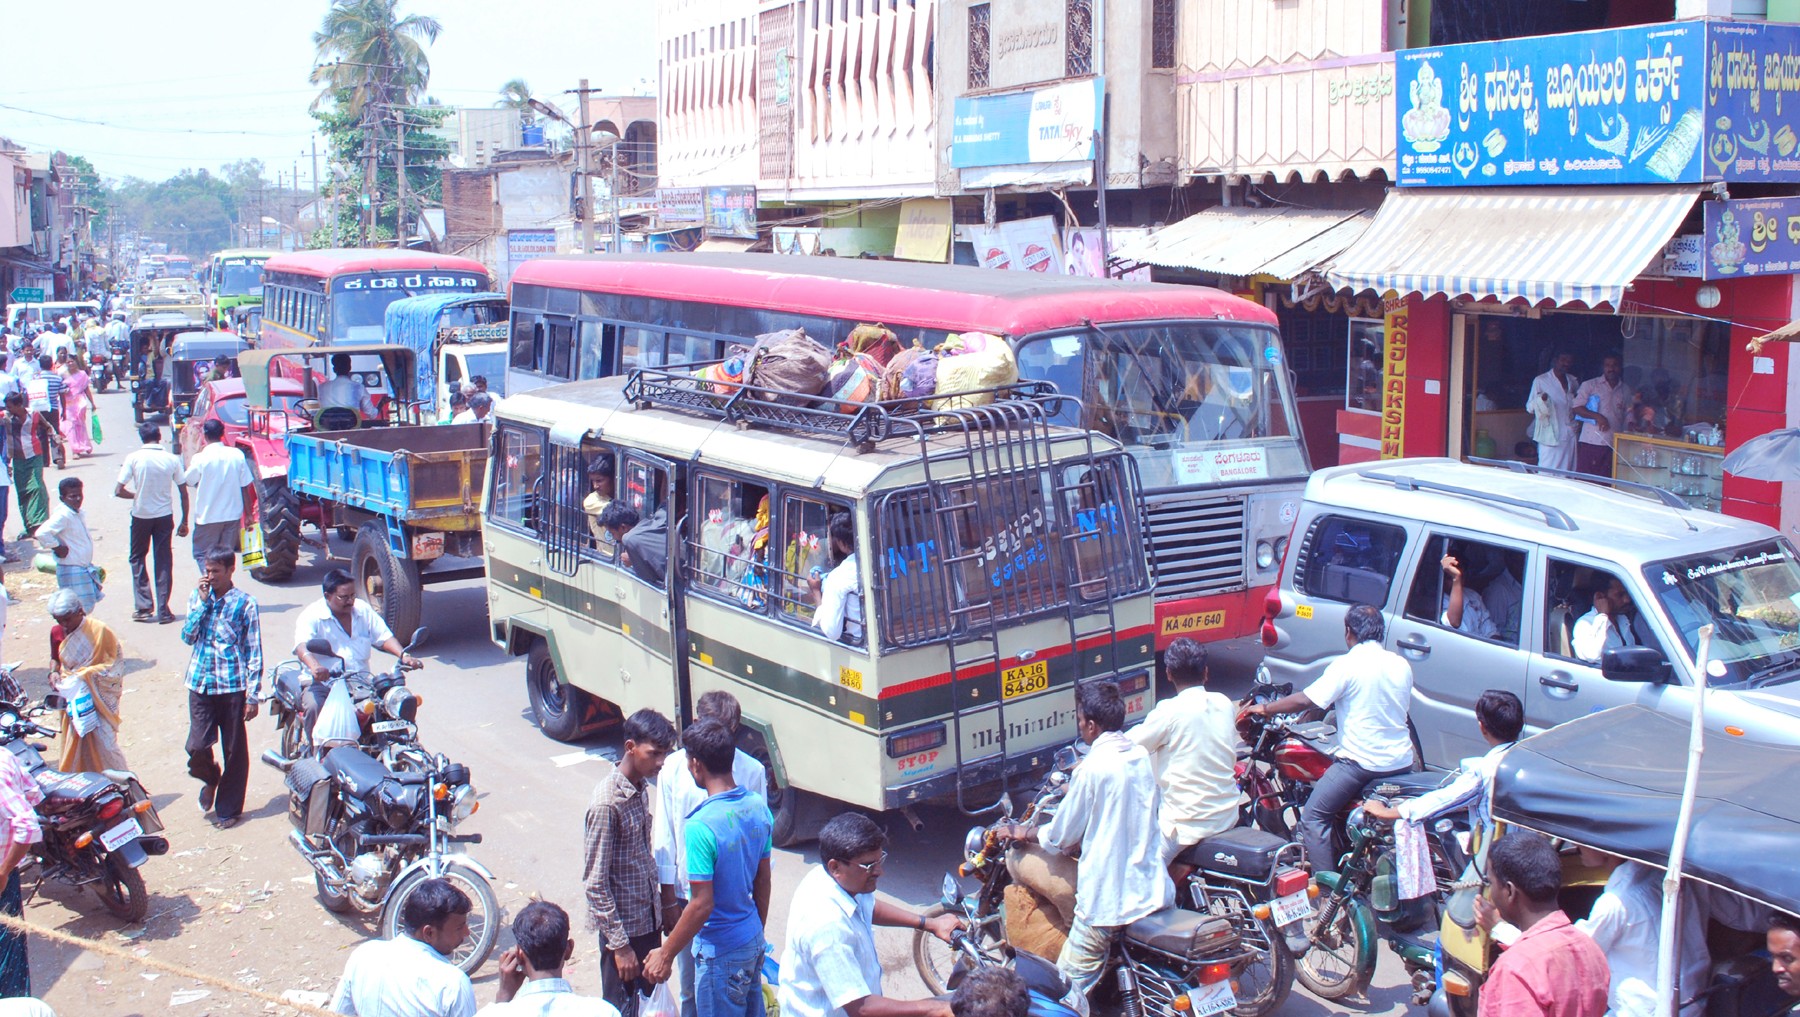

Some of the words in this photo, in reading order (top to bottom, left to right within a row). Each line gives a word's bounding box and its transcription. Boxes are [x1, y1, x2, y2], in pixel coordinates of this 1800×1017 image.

[1458, 62, 1478, 132] ಶ್ರೀ
[1039, 125, 1060, 140] TATA
[1750, 211, 1777, 253] ಶ್ರೀ
[1382, 313, 1408, 459] RAJLAKSHM
[1220, 466, 1257, 476] BANGALORE
[1182, 617, 1194, 628] 40
[1196, 616, 1202, 626] F
[1204, 613, 1221, 626] 640
[1006, 663, 1044, 682] KA-16
[840, 677, 862, 690] 8480
[1004, 675, 1046, 697] 8480
[898, 751, 939, 771] STOP
